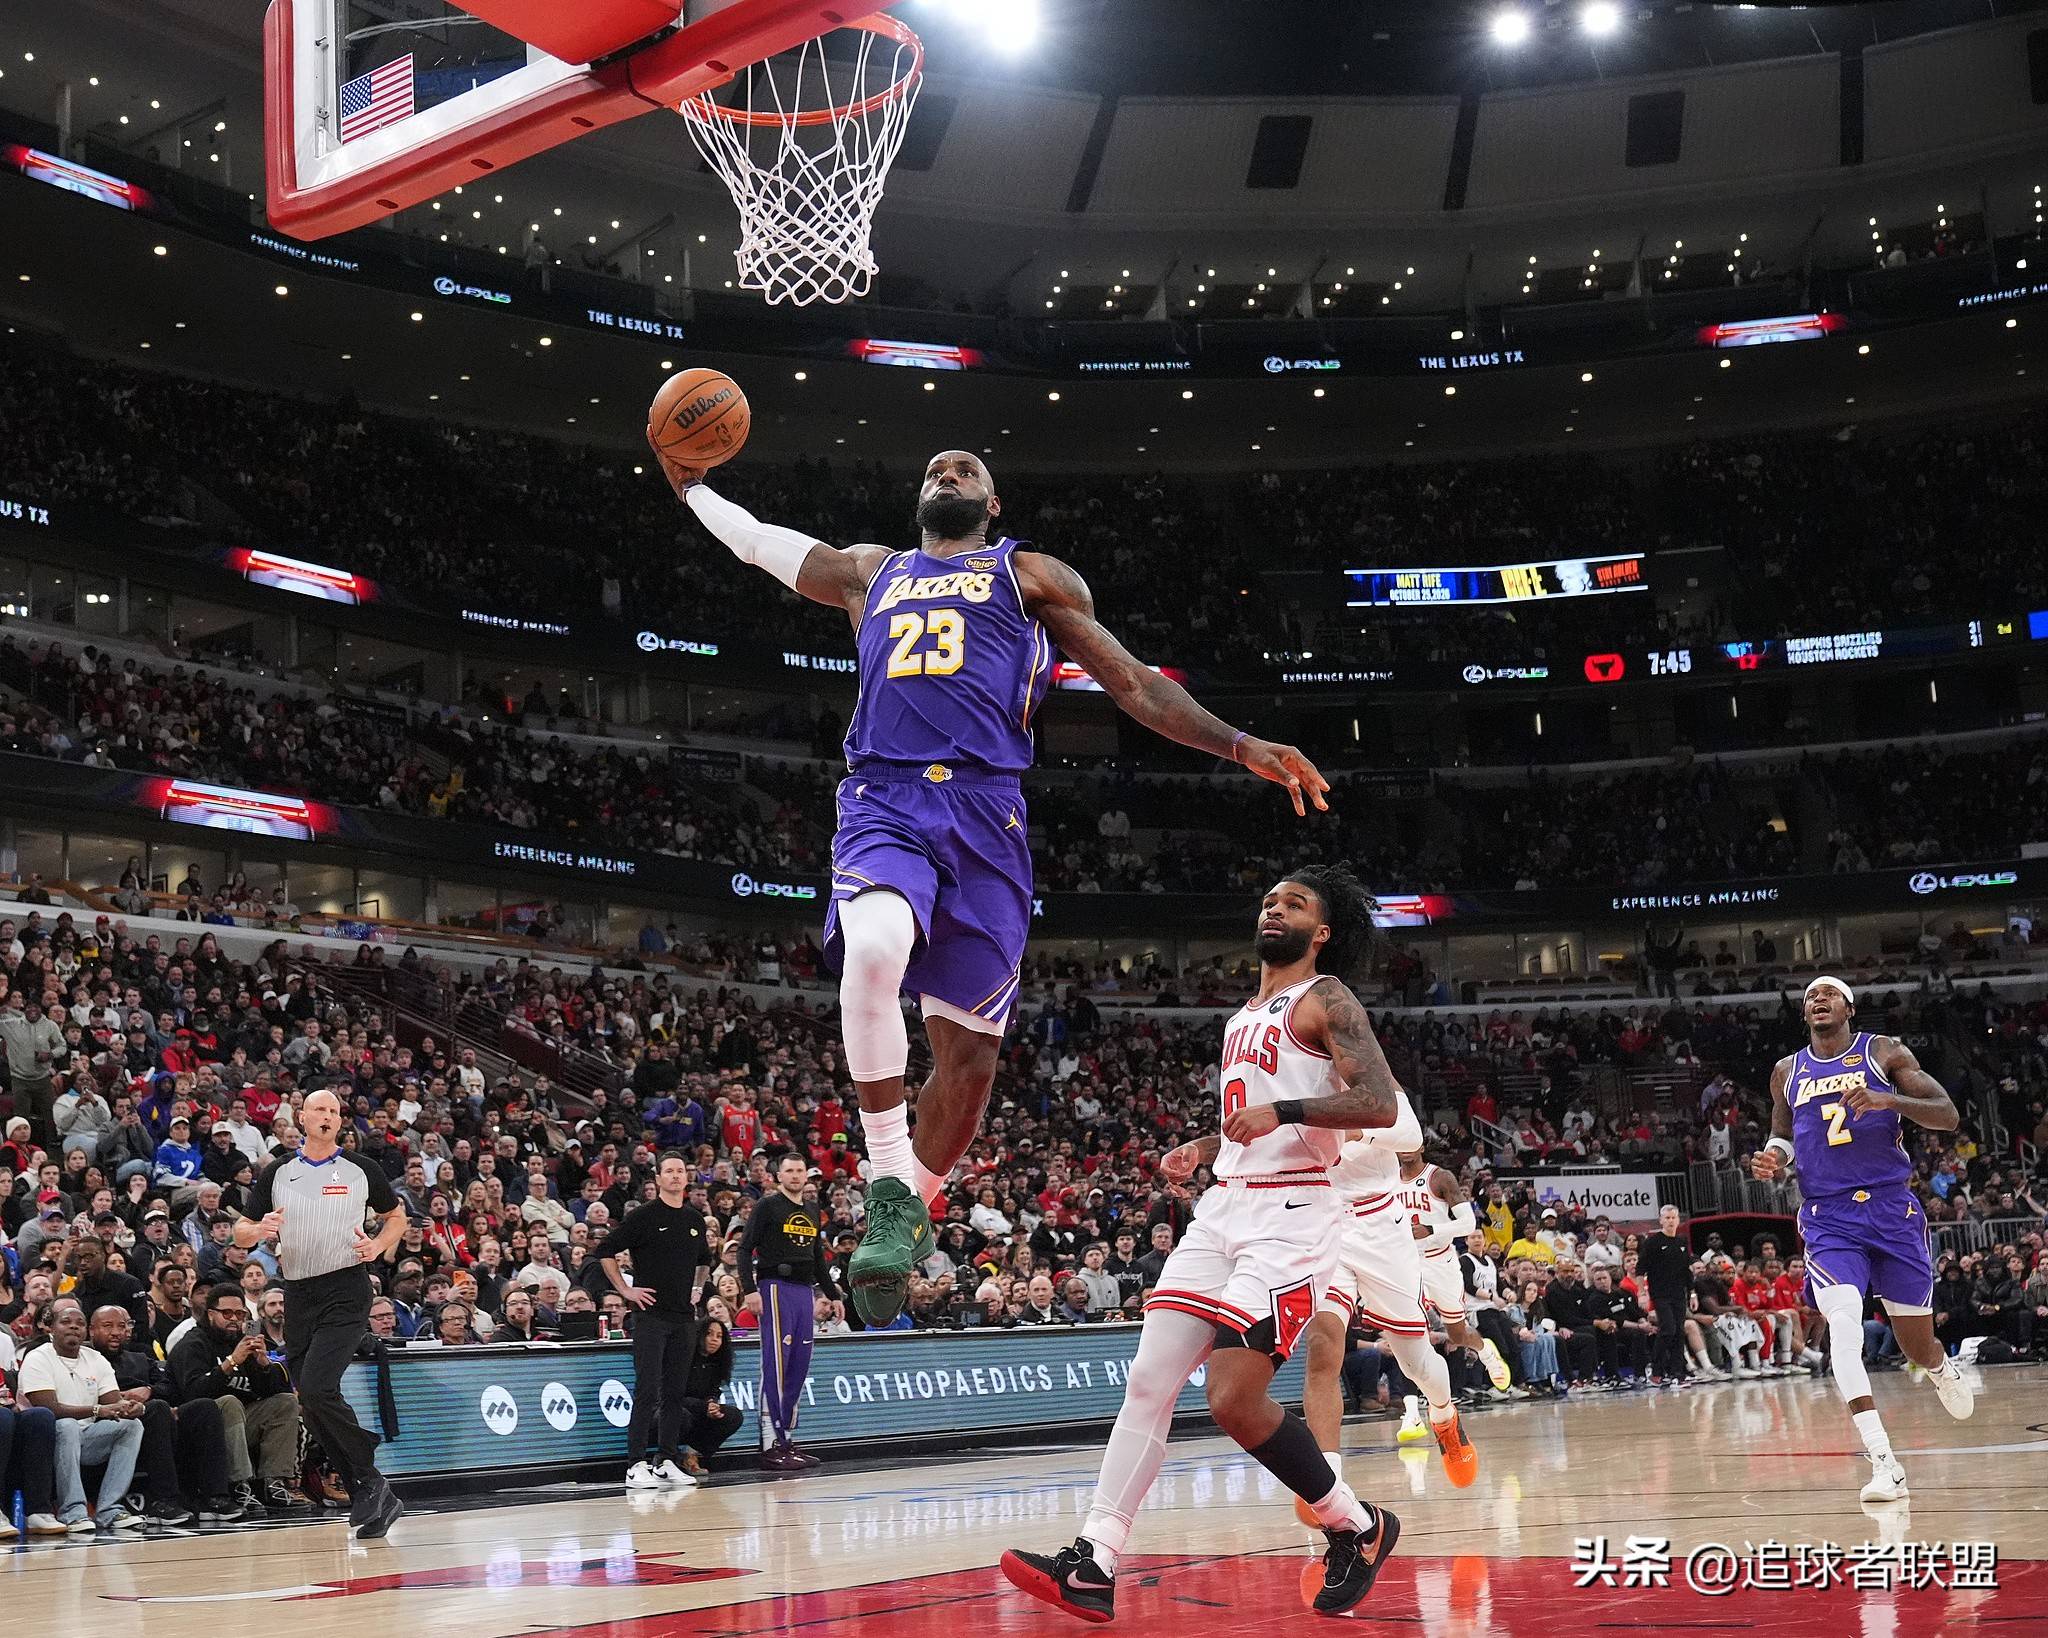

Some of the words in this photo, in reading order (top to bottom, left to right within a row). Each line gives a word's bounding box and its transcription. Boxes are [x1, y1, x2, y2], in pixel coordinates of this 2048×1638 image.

[587, 310, 614, 327] THE
[618, 316, 662, 335] LEXUS
[666, 325, 684, 339] TX
[1420, 356, 1447, 369] THE
[1452, 352, 1500, 368] LEXUS
[1504, 350, 1524, 363] TX
[673, 388, 733, 430] Wilson
[0, 499, 23, 519] US
[28, 505, 49, 526] TX
[1396, 573, 1420, 588] MATT
[872, 572, 995, 617] LAKERS
[887, 608, 965, 679] 23
[1786, 636, 1832, 652] MEMPHIS
[1833, 632, 1882, 648] GRIZZLIES
[1787, 648, 1834, 664] HOUSTON
[1834, 645, 1879, 660] ROCKETS
[783, 652, 808, 668] THE
[812, 656, 857, 673] LEXUS
[1648, 650, 1692, 675] 7:45
[1282, 672, 1344, 683] EXPERIENCE
[1348, 671, 1395, 682] AMAZING
[494, 842, 573, 866] EXPERIENCE
[577, 856, 636, 875] AMAZING
[1939, 871, 2018, 887] LEXUS
[1613, 894, 1702, 909] EXPERIENCE
[1708, 888, 1779, 905] AMAZING
[1222, 1023, 1281, 1076] ULLS
[1794, 1071, 1868, 1108] LAKERS
[1821, 1102, 1853, 1146] 2
[1567, 1188, 1651, 1208] Advocate
[834, 1364, 1053, 1405] ORTHOPAEDICS
[1066, 1362, 1093, 1389] AT
